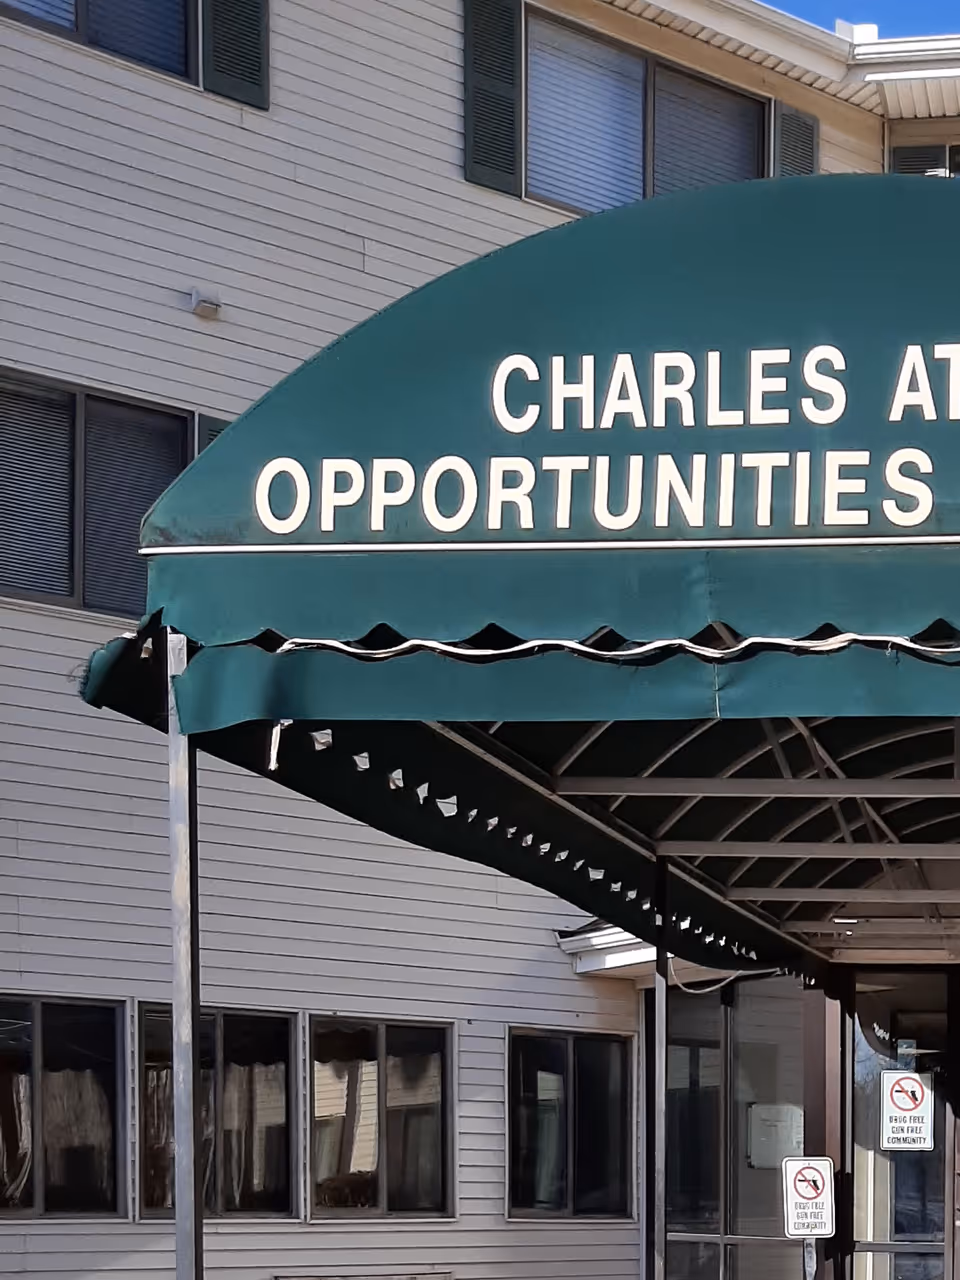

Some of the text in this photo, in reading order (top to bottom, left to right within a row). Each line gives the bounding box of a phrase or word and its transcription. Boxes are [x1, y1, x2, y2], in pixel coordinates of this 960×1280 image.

[492, 343, 848, 434] CHARLES
[254, 446, 934, 535] OPPORTUNITIES
[887, 1136, 927, 1144] COMMUNITY
[909, 1115, 925, 1124] FREE
